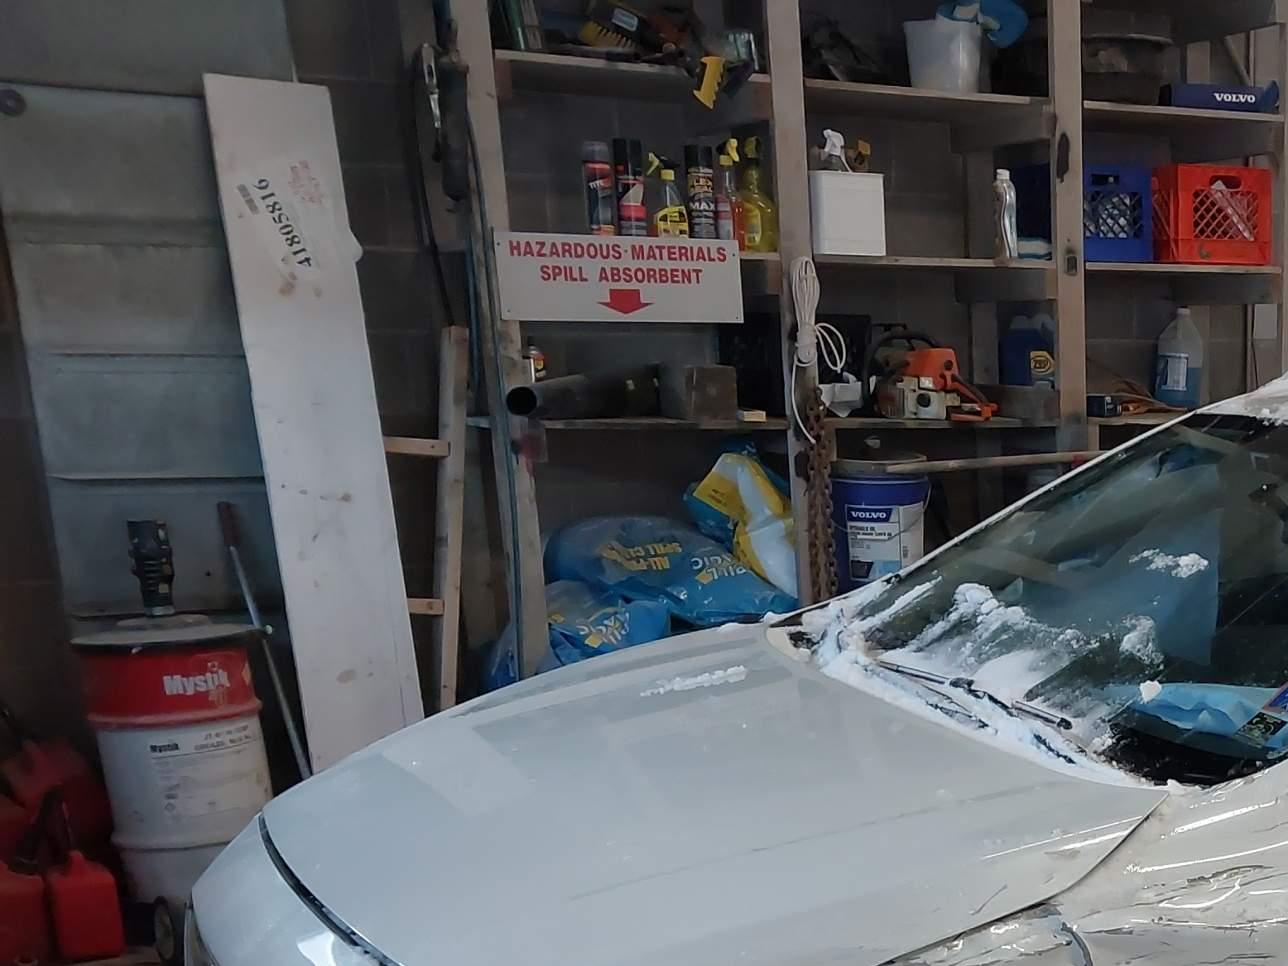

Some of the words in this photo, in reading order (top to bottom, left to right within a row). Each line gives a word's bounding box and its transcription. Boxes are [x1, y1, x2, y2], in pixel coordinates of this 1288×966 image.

[1213, 92, 1256, 103] VOLVO
[691, 202, 715, 210] MAX
[254, 177, 313, 267] 41805816
[508, 239, 623, 261] HAZARDOUS
[630, 244, 728, 263] MATERIALS
[539, 264, 589, 283] SPILL
[597, 266, 704, 285] ABSORBENT
[850, 511, 887, 519] VOLVO
[162, 666, 231, 696] Mystik
